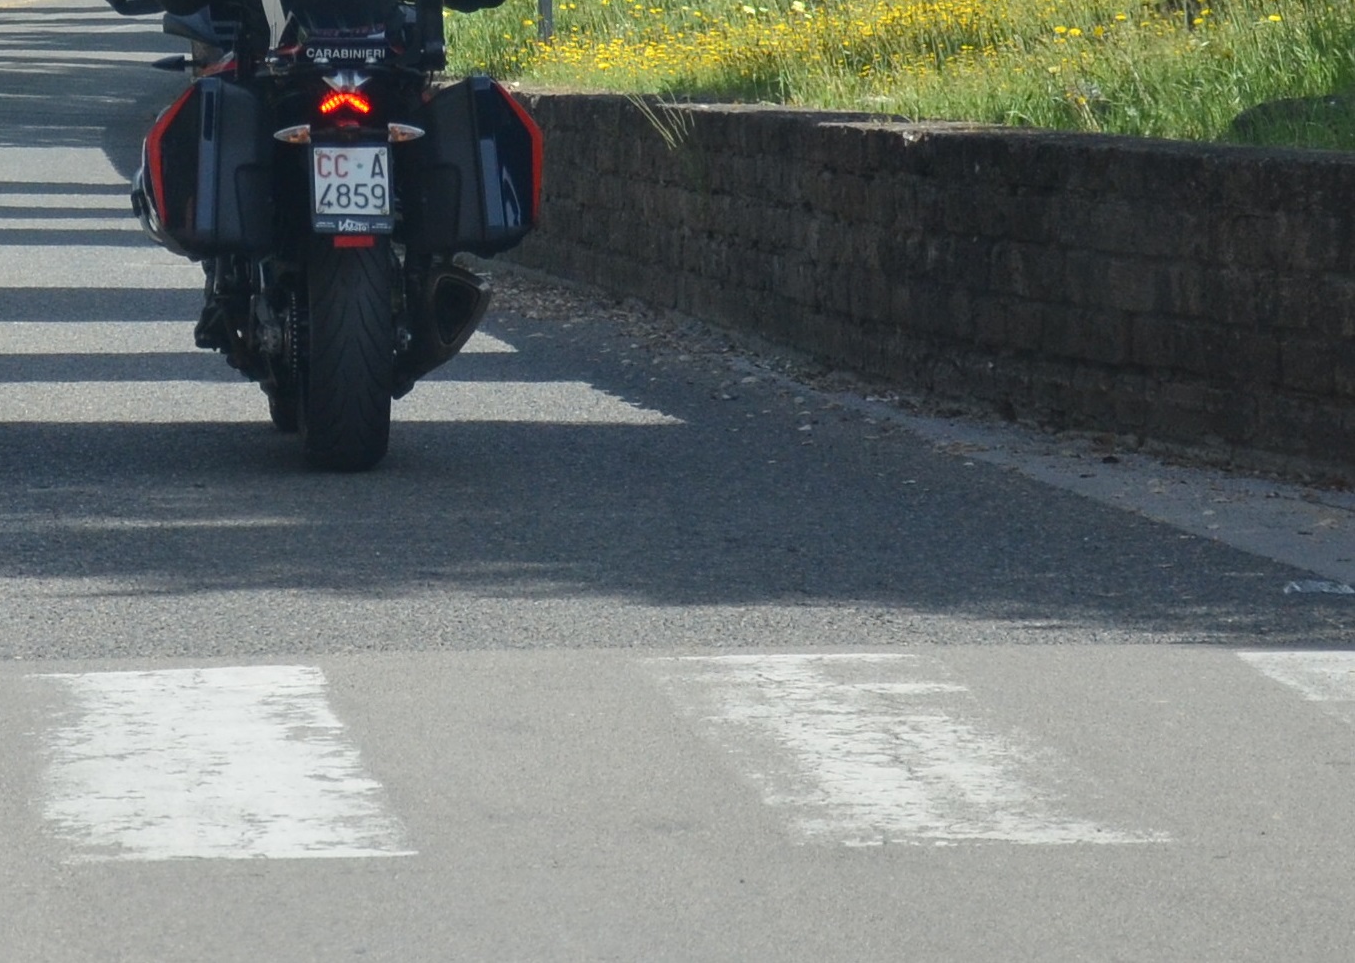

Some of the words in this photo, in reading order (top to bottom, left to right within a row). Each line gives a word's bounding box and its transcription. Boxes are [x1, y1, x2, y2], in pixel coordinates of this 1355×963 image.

[306, 48, 386, 58] CARABINIERI
[317, 153, 349, 178] CC
[370, 153, 385, 179] A
[319, 183, 387, 210] 4859
